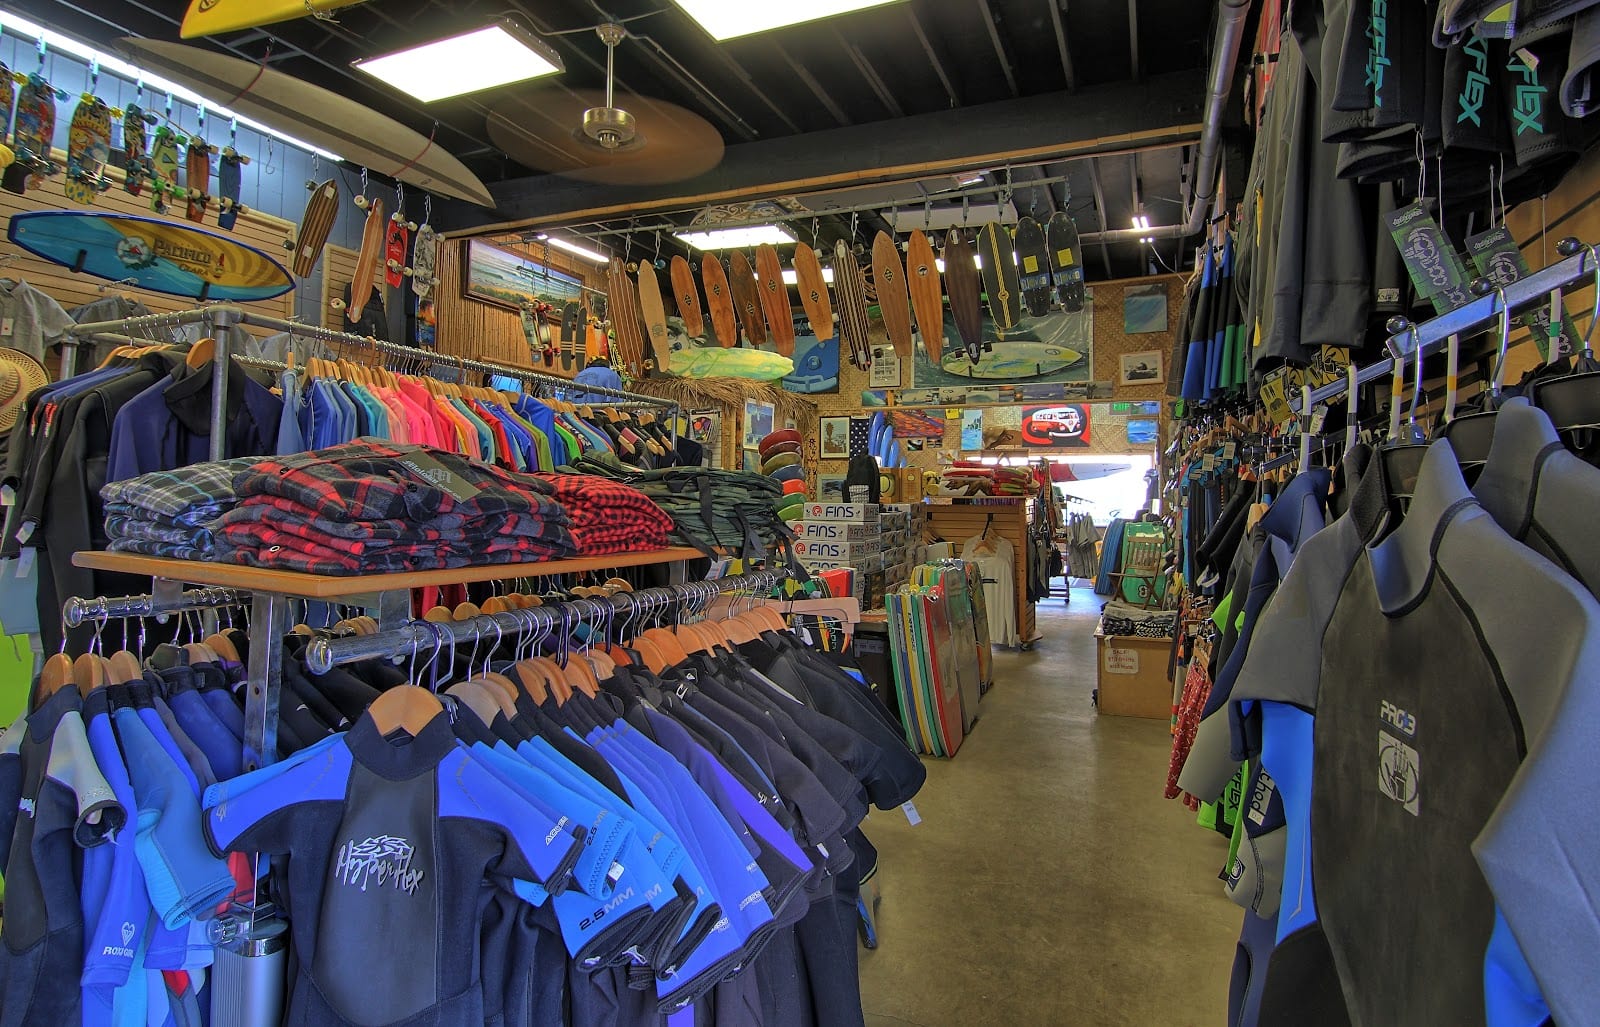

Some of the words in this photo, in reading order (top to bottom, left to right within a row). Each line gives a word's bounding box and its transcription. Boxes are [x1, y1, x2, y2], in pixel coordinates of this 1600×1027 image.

[154, 238, 212, 266] PACIFICO
[825, 506, 854, 518] FINS
[807, 525, 837, 538] FINS
[809, 544, 839, 557] FINS
[579, 886, 635, 932] 2.5MM
